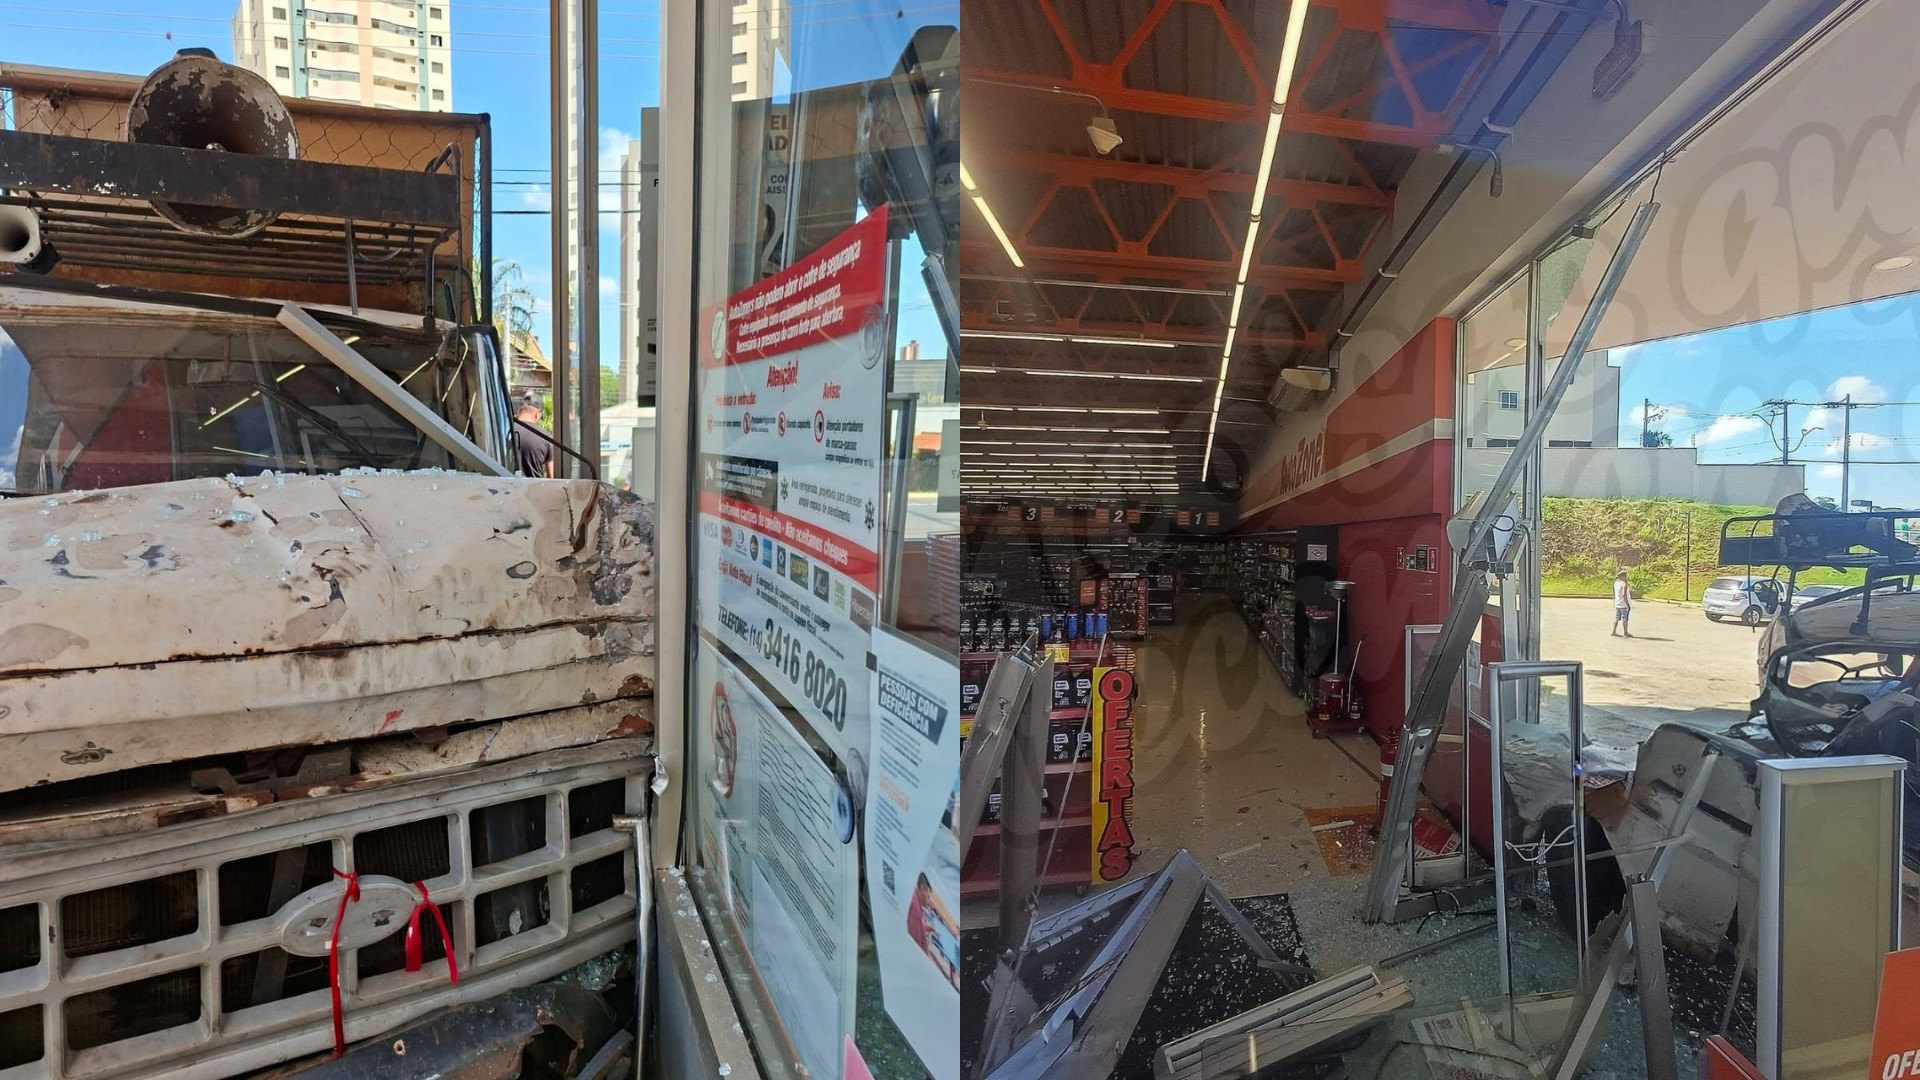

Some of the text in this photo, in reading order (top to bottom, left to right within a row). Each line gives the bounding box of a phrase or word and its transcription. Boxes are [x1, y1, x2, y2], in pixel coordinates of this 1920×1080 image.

[765, 285, 784, 310] podem
[784, 275, 798, 298] abrir
[803, 265, 818, 289] cofre
[818, 259, 827, 280] de
[827, 239, 861, 277] segurança
[767, 360, 798, 391] Atenção!
[1280, 432, 1324, 495] AutoZone
[702, 521, 719, 540] VISA
[1026, 507, 1037, 521] 3
[1113, 510, 1124, 523] 2
[1194, 513, 1203, 525] 1
[785, 521, 795, 539] Não
[795, 528, 823, 552] aceitamos
[823, 538, 849, 566] cheques
[718, 605, 749, 641] TELEFONE:
[750, 624, 762, 653] (14)
[764, 617, 801, 685] 3416
[803, 650, 847, 732] 8020
[880, 690, 929, 736] DEFICIÊNCIA
[881, 673, 917, 707] PESSOAS
[918, 696, 938, 722] COM
[1099, 670, 1134, 880] OFERTAS
